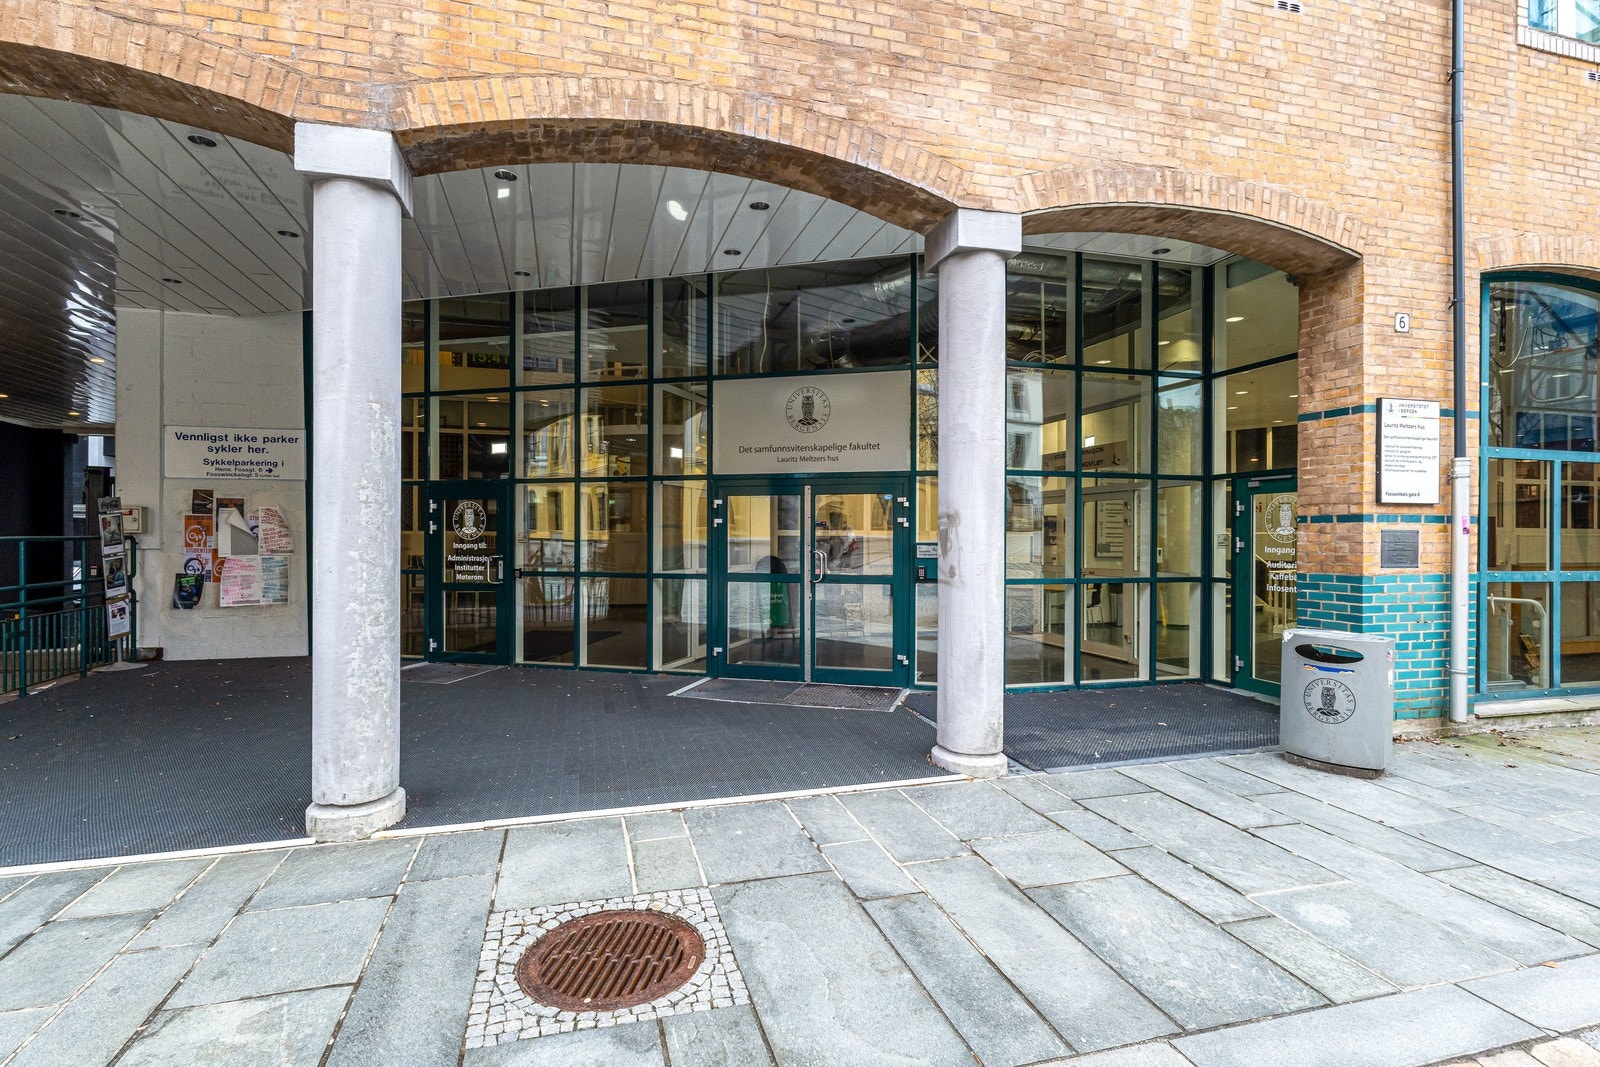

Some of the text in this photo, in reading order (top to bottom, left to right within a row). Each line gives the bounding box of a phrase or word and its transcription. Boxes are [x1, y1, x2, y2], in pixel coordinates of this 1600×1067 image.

[1400, 316, 1406, 329] 6
[472, 352, 509, 364] 15:41
[788, 387, 829, 410] UNIVERSITAS
[788, 413, 828, 432] BERGENSIS
[175, 432, 299, 444] Vennligst ikke parker
[207, 445, 269, 454] sykler her.
[738, 442, 880, 454] Det samfunnsvitenskapelige fakultet
[203, 458, 278, 468] Sykkelparkering
[454, 502, 485, 520] UNIVERSITAS
[454, 524, 484, 538] BERGENSIS
[1265, 546, 1295, 555] Inngang
[1266, 584, 1297, 593] Infosent
[1306, 680, 1353, 703] UNIVERSITAS
[1306, 702, 1352, 722] BERGENSIS
